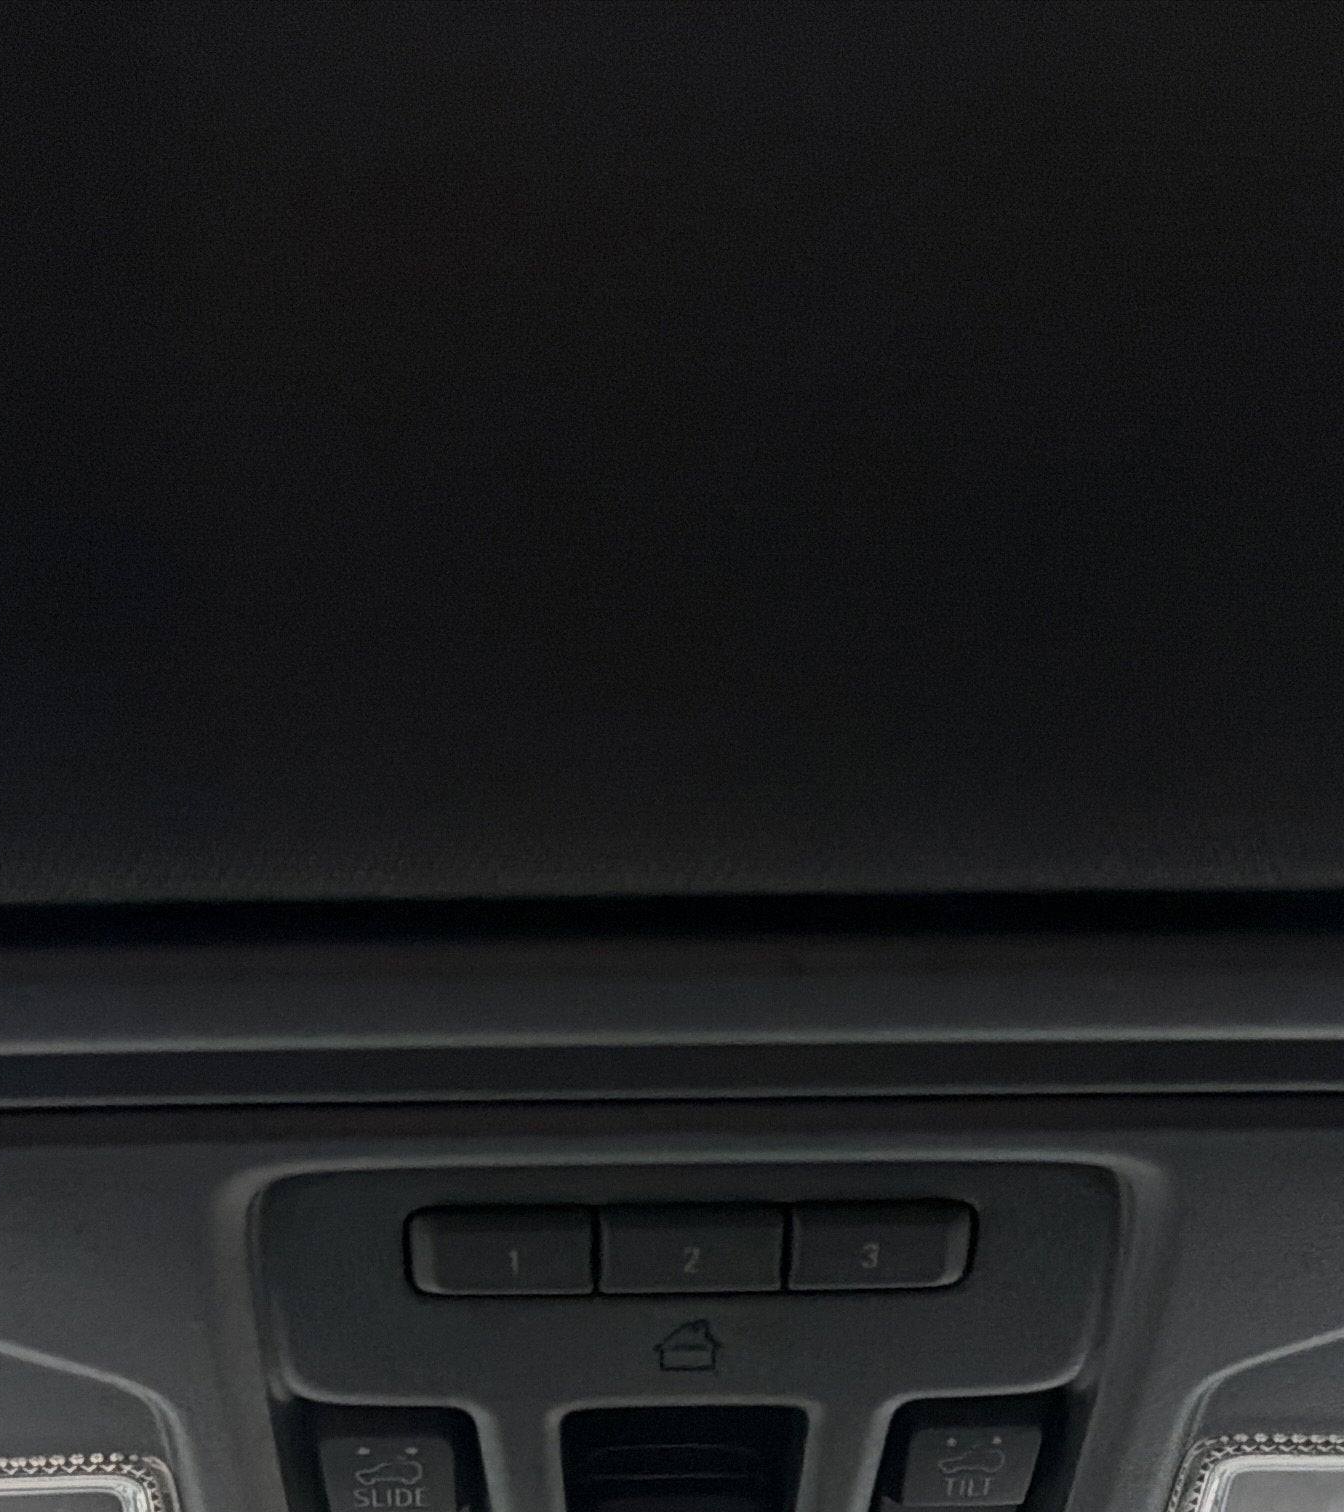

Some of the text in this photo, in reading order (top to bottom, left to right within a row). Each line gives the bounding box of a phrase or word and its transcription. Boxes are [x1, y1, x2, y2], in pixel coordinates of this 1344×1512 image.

[507, 1248, 520, 1276] 1
[682, 1245, 701, 1274] 2
[860, 1241, 881, 1269] 3
[352, 1486, 431, 1509] SLIDE
[944, 1476, 996, 1498] TILT
